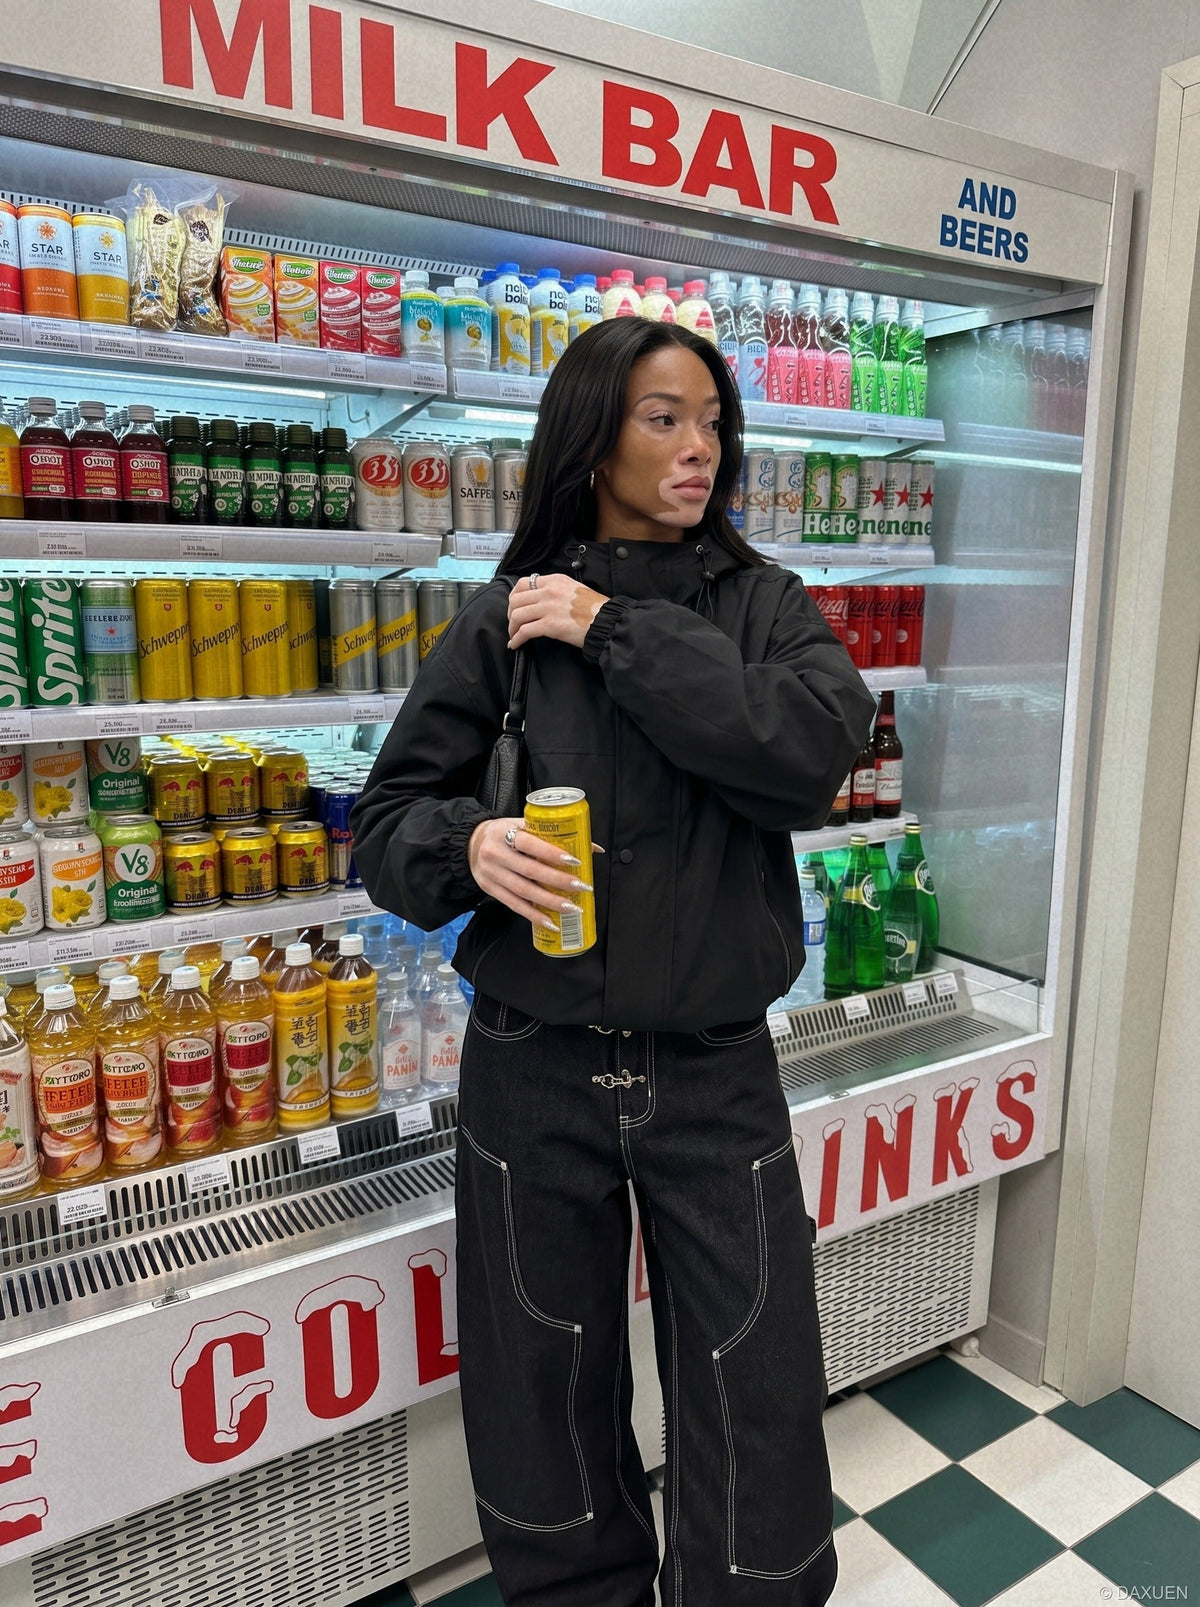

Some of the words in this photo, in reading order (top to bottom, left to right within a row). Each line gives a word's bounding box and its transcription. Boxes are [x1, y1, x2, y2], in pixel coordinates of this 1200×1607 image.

[160, 0, 559, 167] MILK
[602, 80, 839, 226] BAR
[957, 178, 1017, 221] AND
[31, 243, 64, 256] STAR
[93, 251, 122, 264] STAR
[939, 214, 1029, 264] BEERS
[30, 579, 84, 705] Sprite
[104, 741, 131, 767] V8
[102, 775, 140, 789] Original
[120, 849, 149, 876] V8
[816, 1060, 1038, 1231] INKS
[171, 1248, 460, 1465] COL
